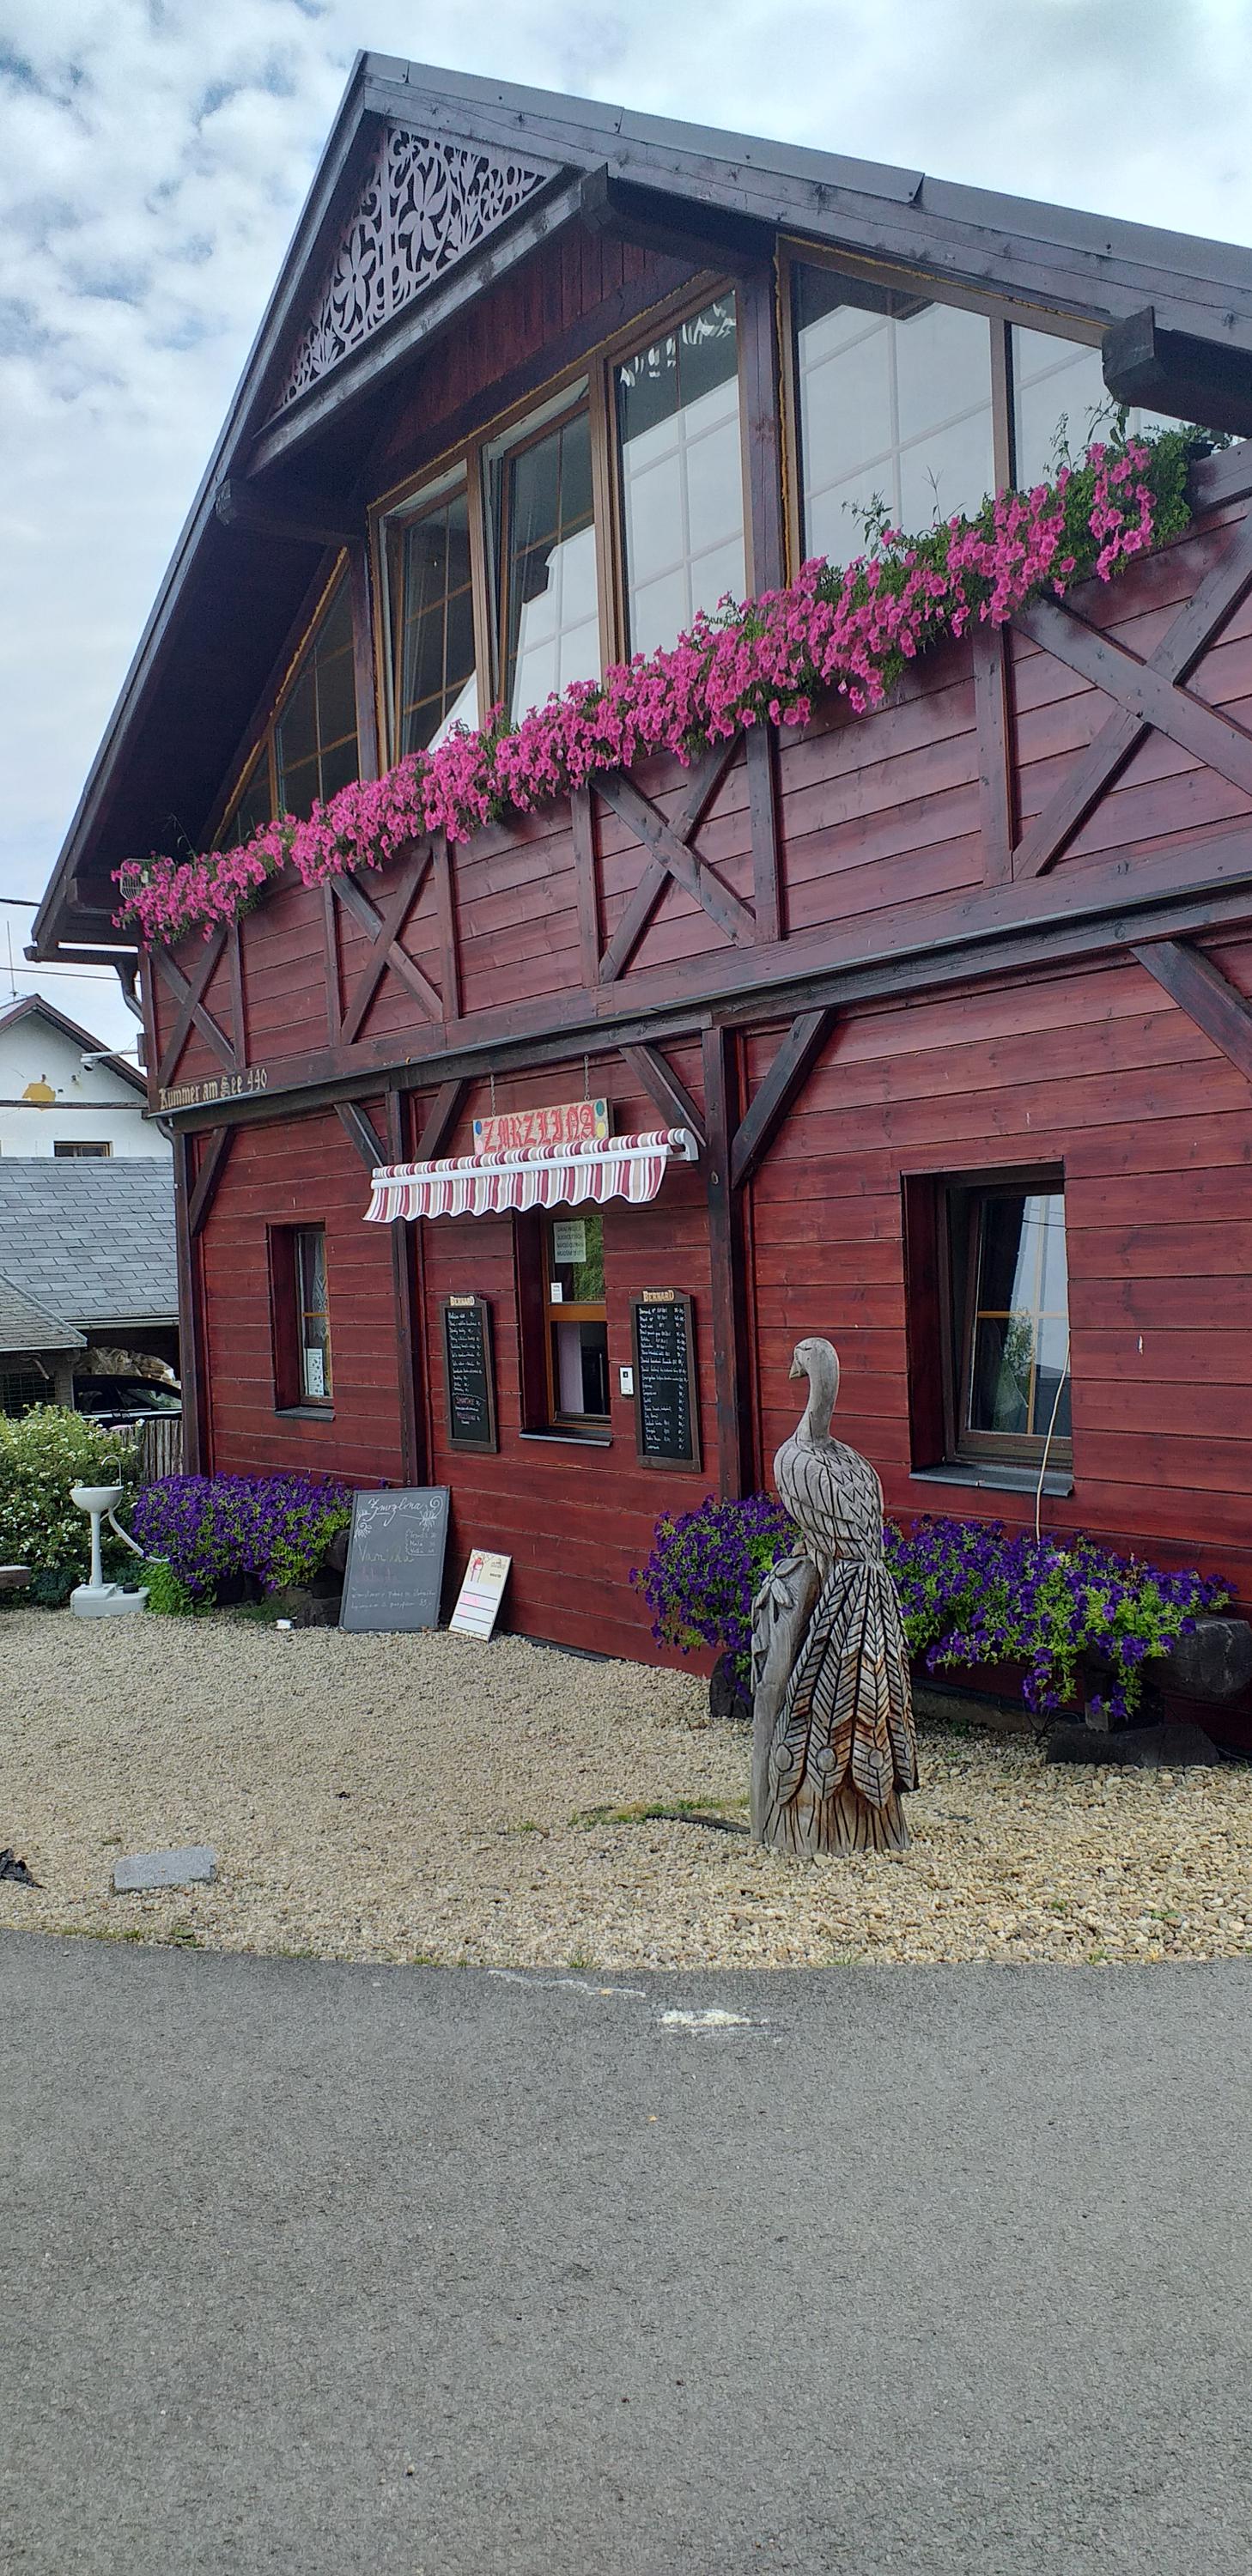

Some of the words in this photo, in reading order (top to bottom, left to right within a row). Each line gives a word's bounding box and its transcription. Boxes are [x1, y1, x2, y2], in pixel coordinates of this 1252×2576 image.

[203, 1080, 218, 1101] am
[221, 1075, 243, 1097] See
[246, 1068, 268, 1091] 440
[483, 1104, 596, 1153] ZMRZLINA
